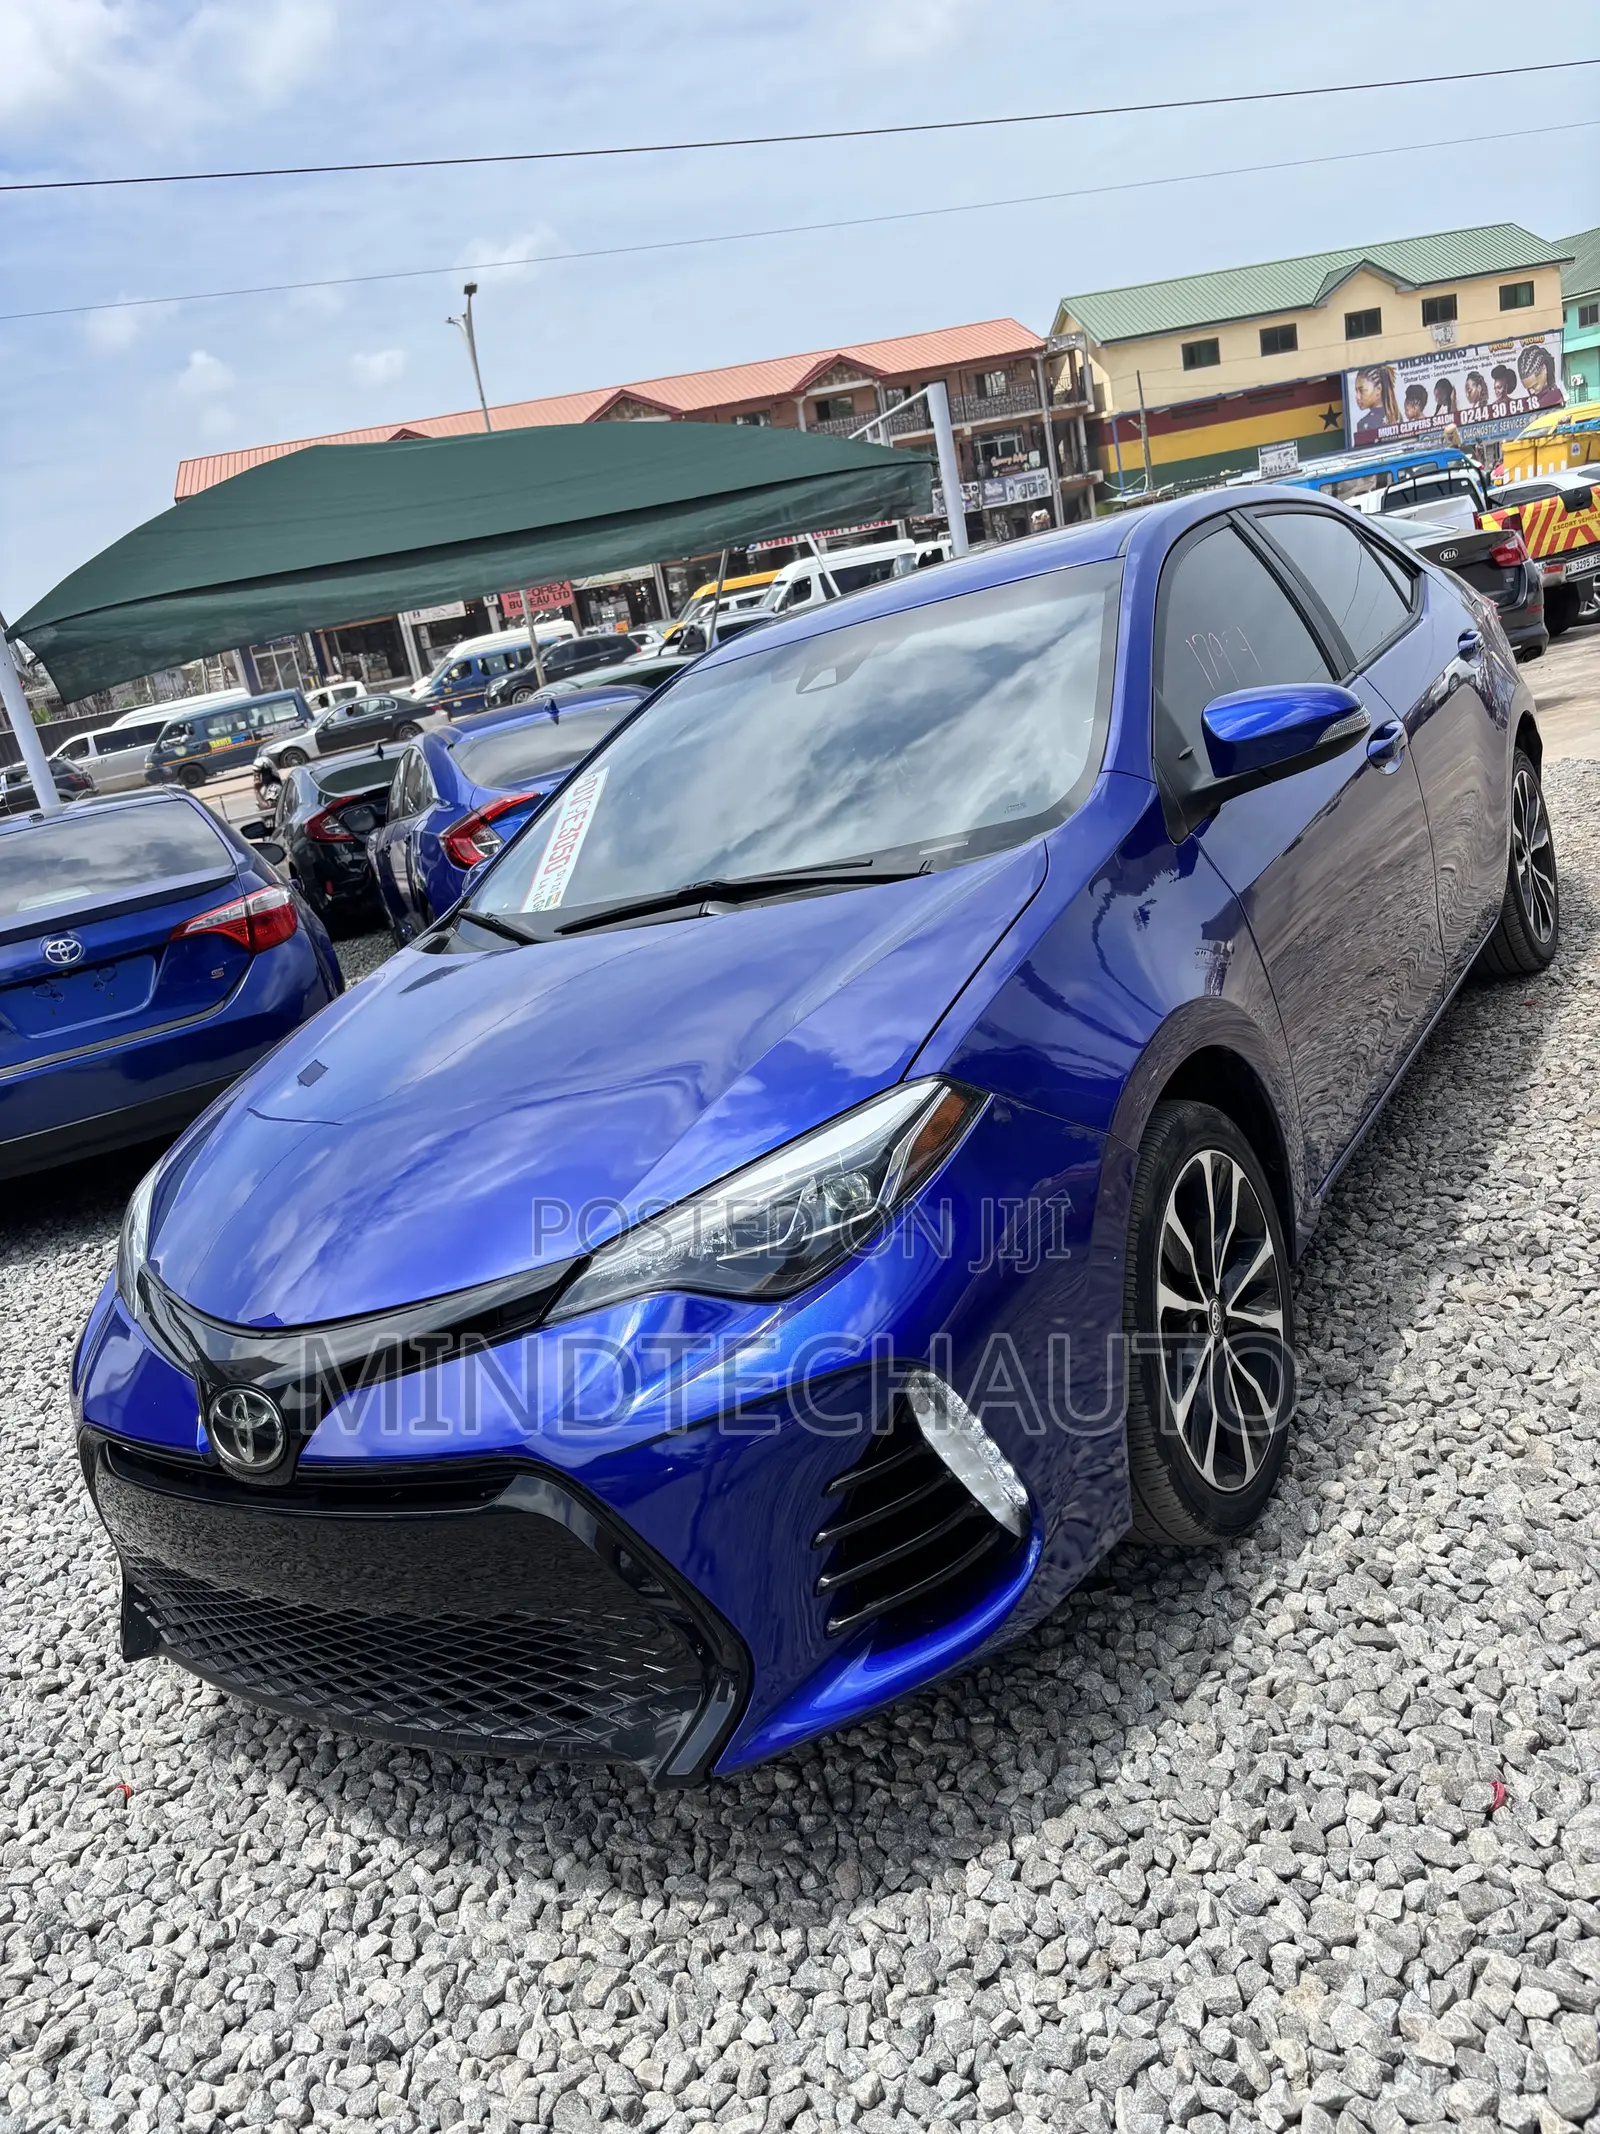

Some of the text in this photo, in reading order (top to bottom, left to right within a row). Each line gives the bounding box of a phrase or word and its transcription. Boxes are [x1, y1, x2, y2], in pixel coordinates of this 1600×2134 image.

[1460, 396, 1540, 425] 0244 30 64 18
[1378, 426, 1399, 438] MULTI
[1400, 420, 1431, 434] CLIPPERS
[1433, 414, 1455, 426] SALON
[1463, 423, 1498, 439] DIAGNOSTIC
[1500, 417, 1527, 432] SERVICES
[1553, 519, 1577, 532] ESCORT
[509, 595, 550, 610] BUEAU
[553, 590, 570, 602] LTD
